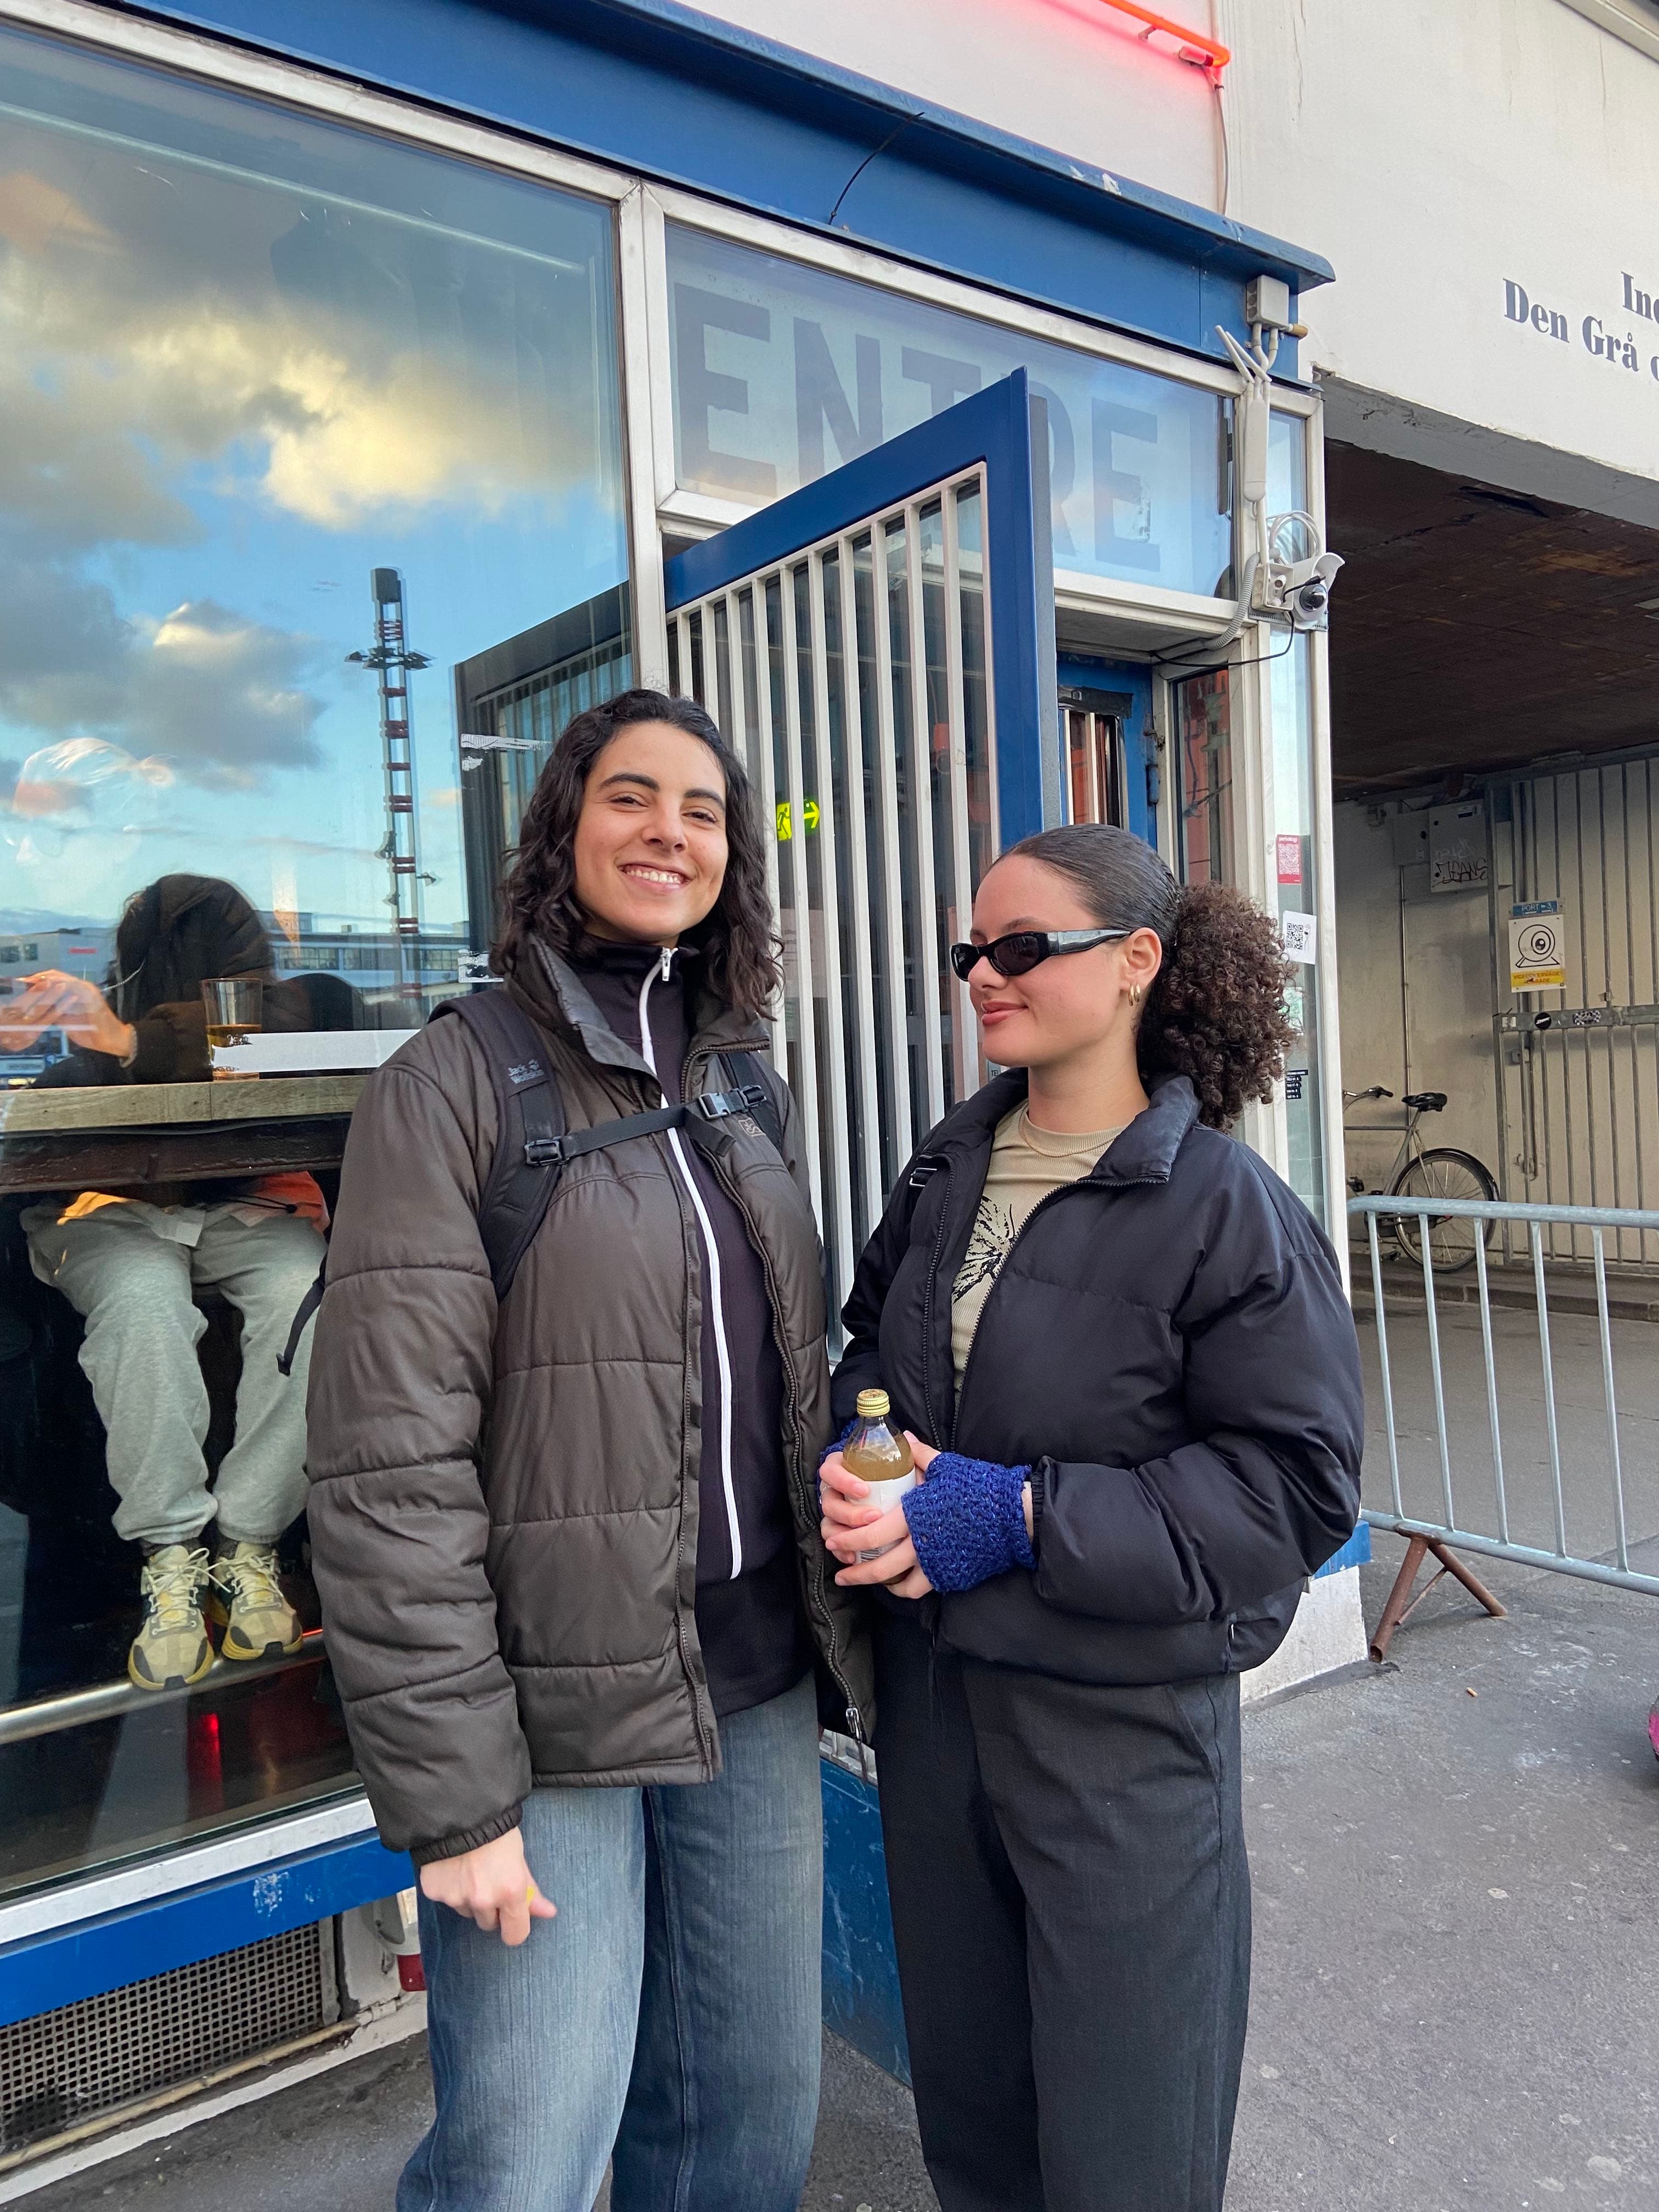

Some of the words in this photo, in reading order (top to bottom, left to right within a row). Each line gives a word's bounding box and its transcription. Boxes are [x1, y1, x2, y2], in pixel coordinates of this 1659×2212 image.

[1502, 278, 1570, 343] Den
[1582, 315, 1640, 372] Grå
[1521, 904, 1539, 912] PORT
